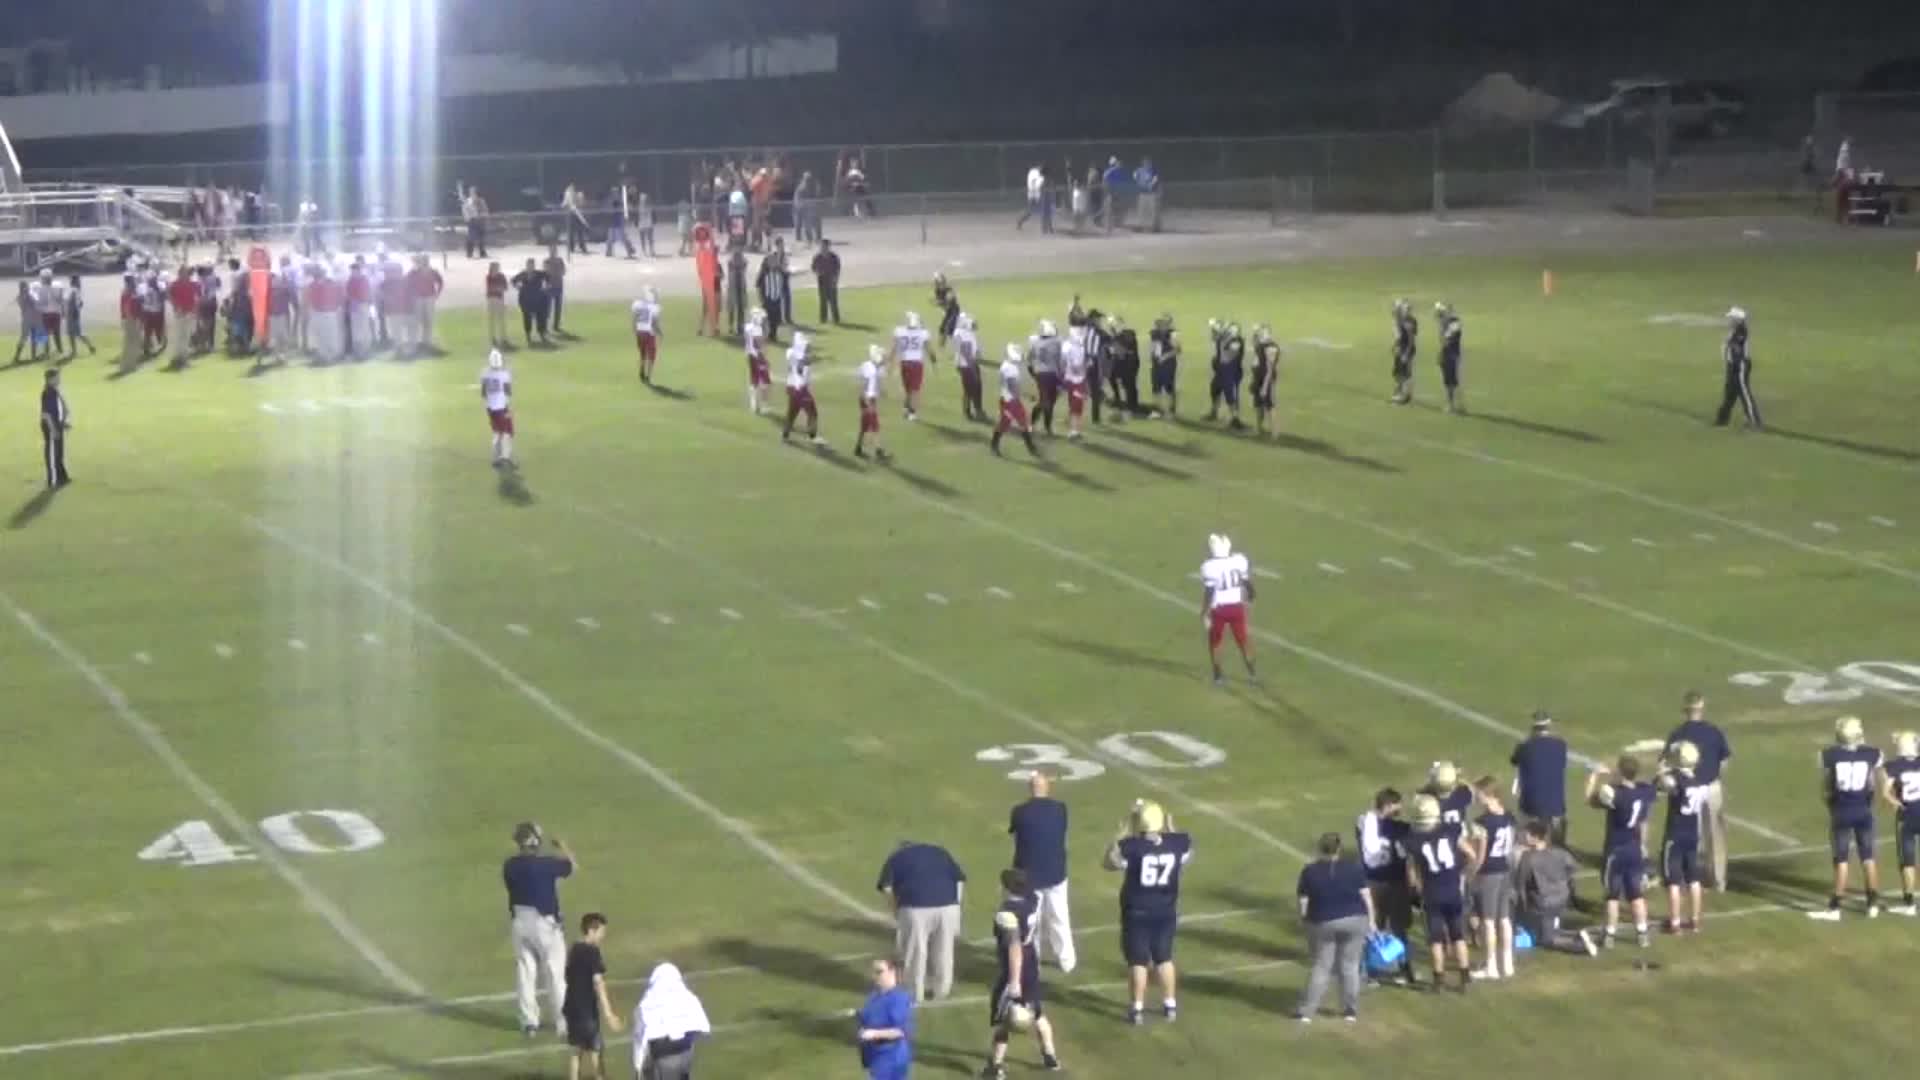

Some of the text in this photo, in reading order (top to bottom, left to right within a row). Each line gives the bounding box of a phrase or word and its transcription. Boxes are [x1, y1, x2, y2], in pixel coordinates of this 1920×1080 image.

[976, 730, 1227, 780] 30
[1627, 799, 1642, 828] 1
[137, 808, 385, 866] 40
[1141, 853, 1176, 887] 67
[1422, 838, 1456, 872] 14
